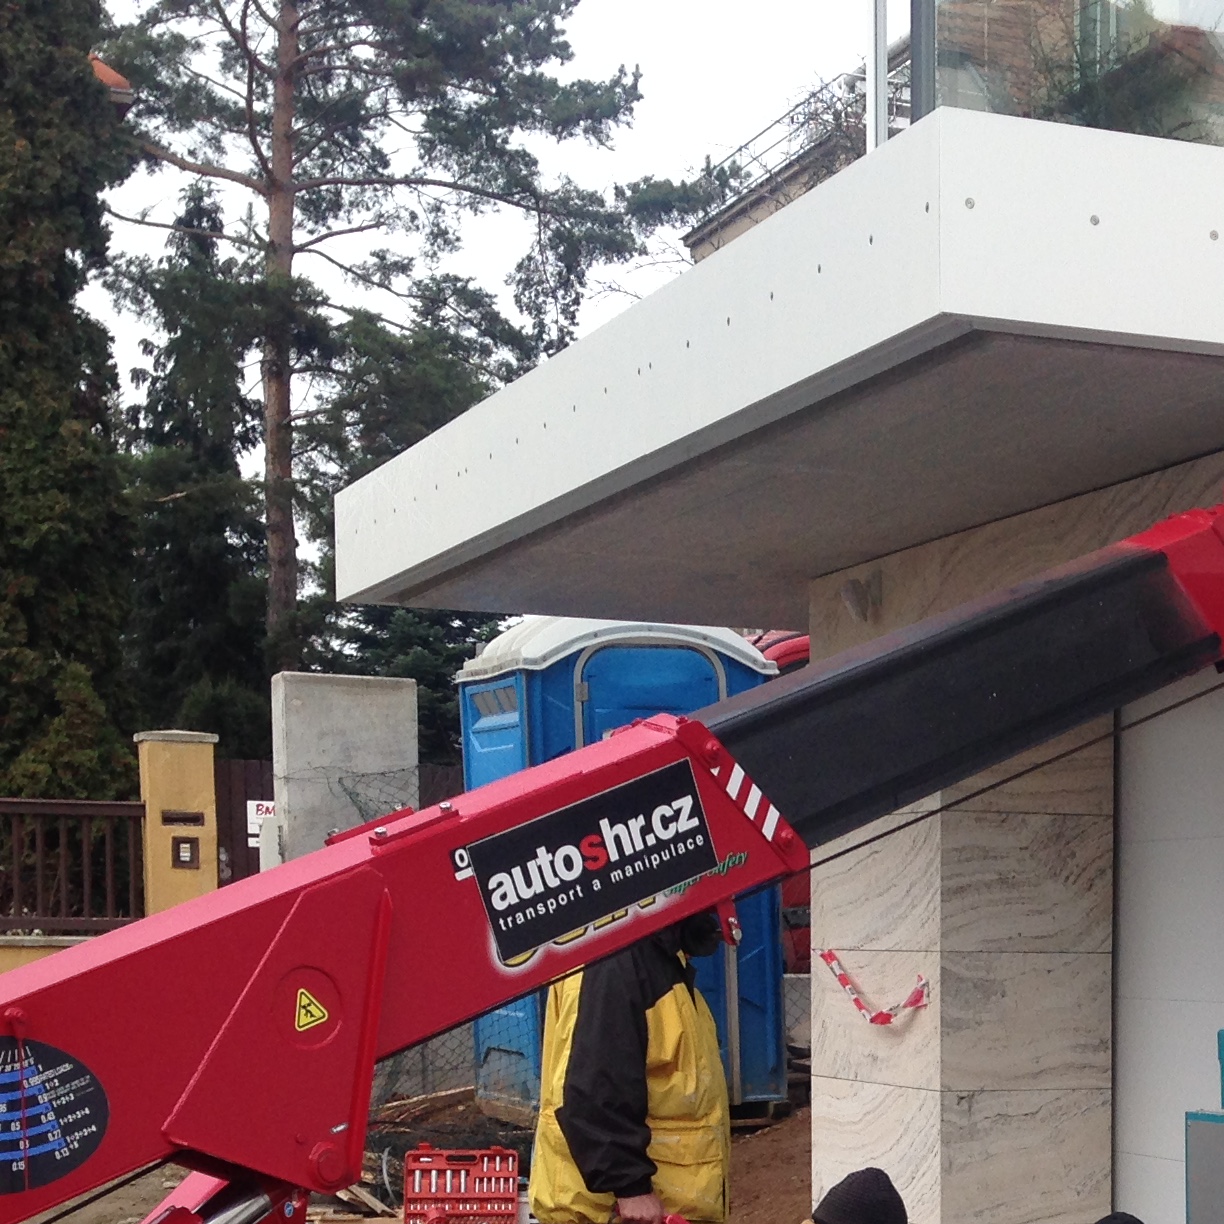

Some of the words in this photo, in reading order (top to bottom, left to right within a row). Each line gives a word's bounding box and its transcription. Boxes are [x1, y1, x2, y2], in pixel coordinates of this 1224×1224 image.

[256, 803, 276, 816] BM
[488, 795, 699, 910] autoshr.cz
[499, 887, 584, 931] transport
[592, 879, 602, 891] a
[610, 834, 705, 883] manipulace
